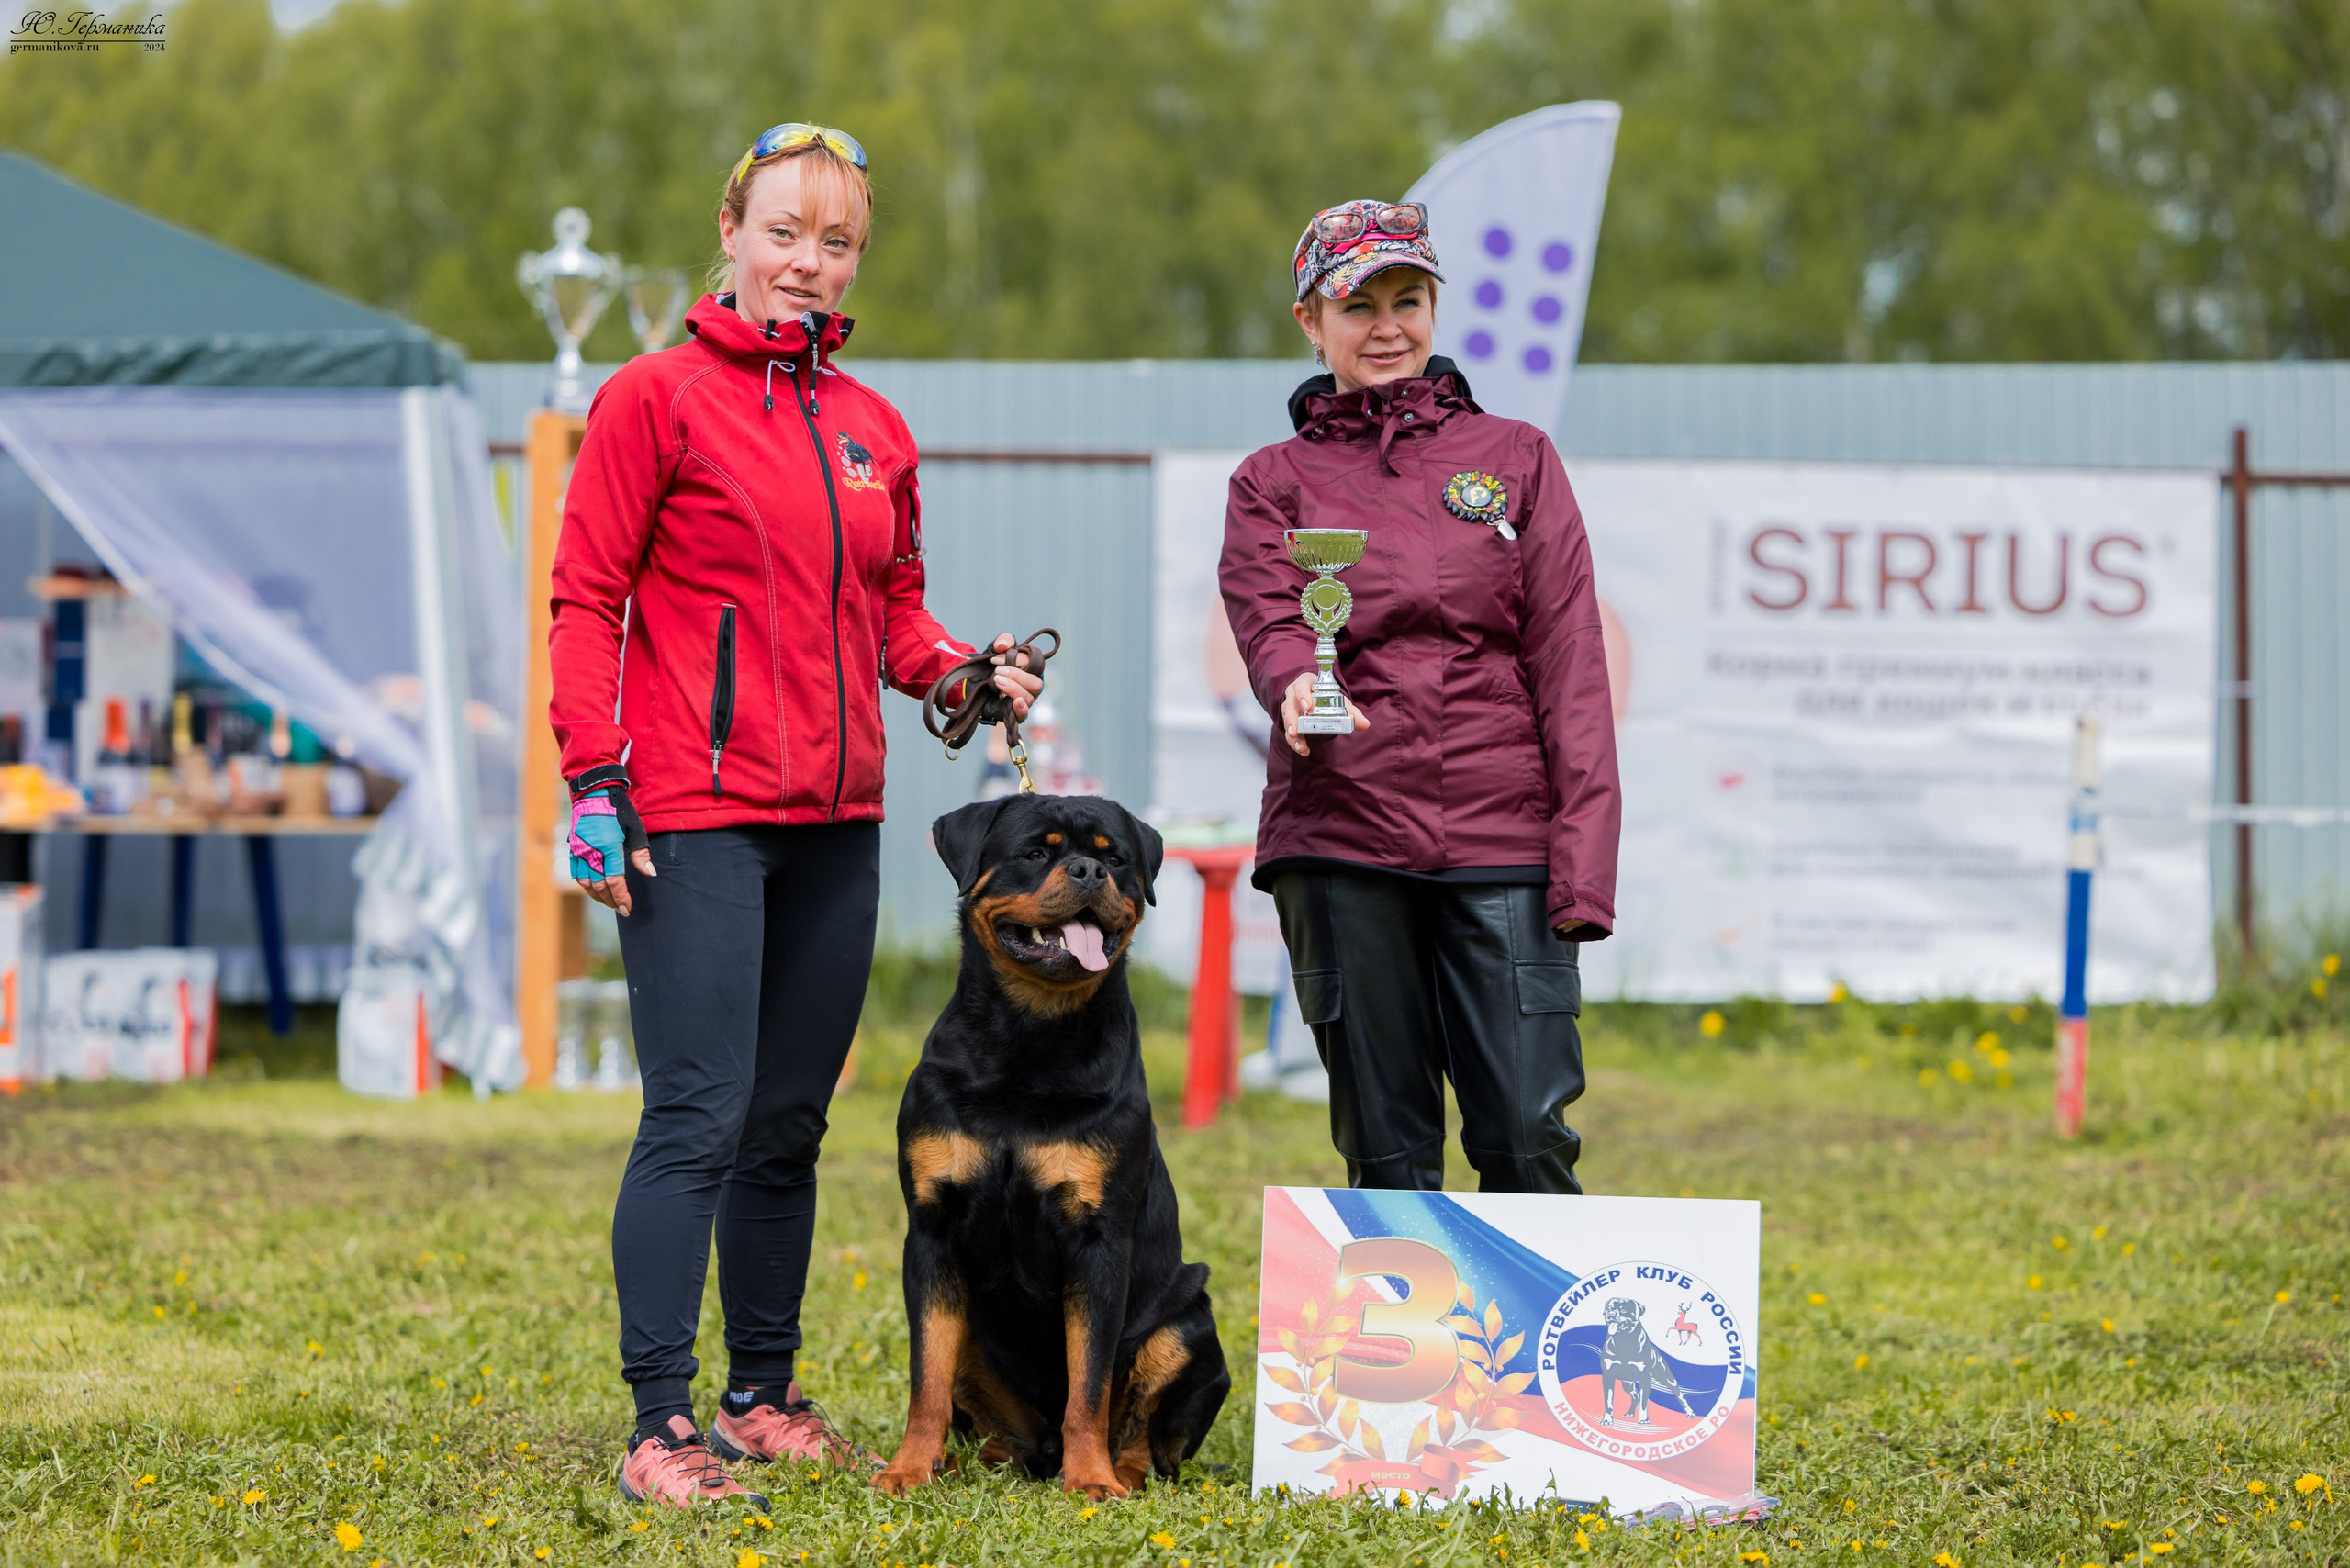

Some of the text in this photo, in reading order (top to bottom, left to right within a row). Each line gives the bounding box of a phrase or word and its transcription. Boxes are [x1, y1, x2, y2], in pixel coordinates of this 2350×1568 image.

[1749, 527, 2149, 619] SIRIUS
[1333, 1236, 1460, 1405] 3
[1542, 1266, 1742, 1375] РОТВЕЙЛЕР КЛУБ РОССИИ
[1371, 1471, 1411, 1480] место
[1554, 1402, 1729, 1460] НИЖЕГОРОДСКОЕ РО
